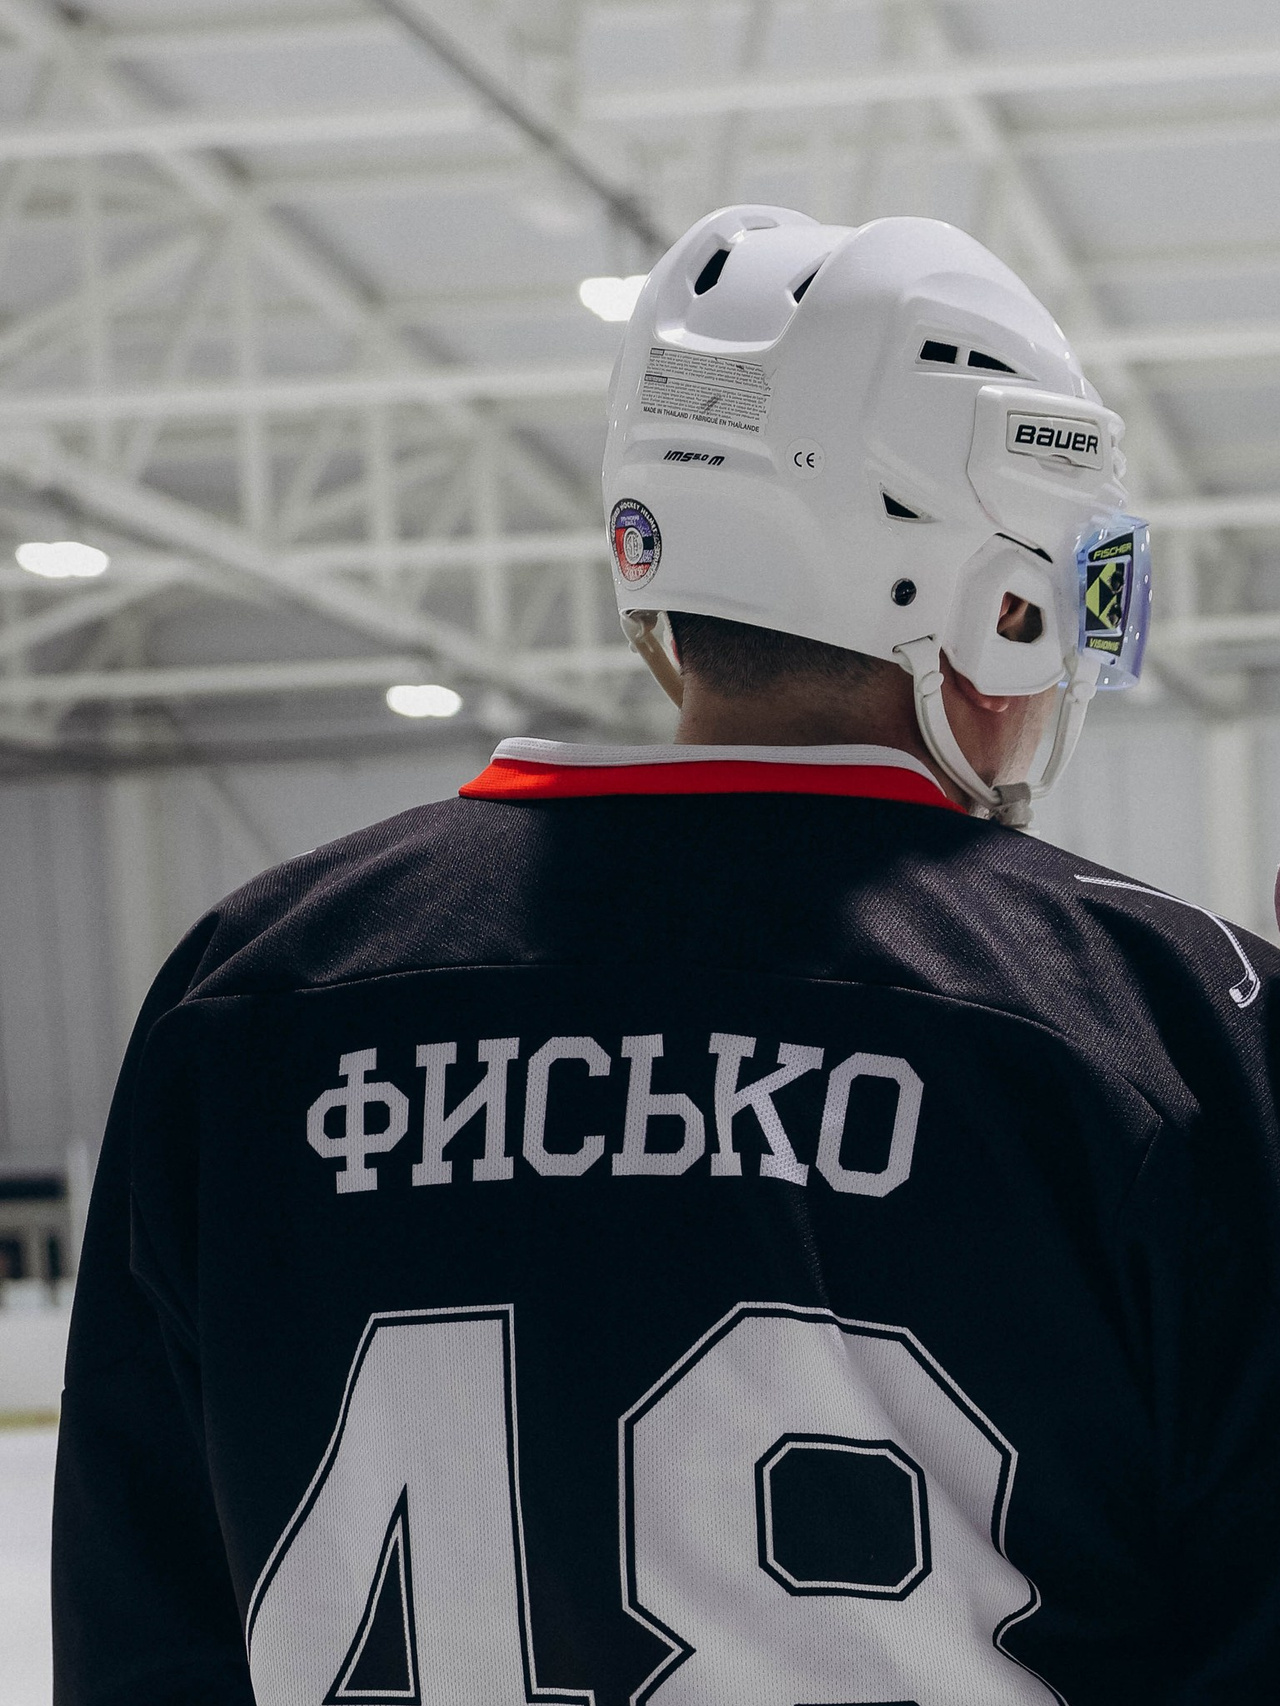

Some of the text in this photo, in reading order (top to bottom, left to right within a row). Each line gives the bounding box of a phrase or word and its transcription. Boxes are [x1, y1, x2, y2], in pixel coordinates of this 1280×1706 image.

[643, 406, 656, 414] MADE
[663, 409, 688, 419] THAILAND
[1093, 542, 1132, 560] FISCHER
[306, 1032, 924, 1198] ФИСЬКО
